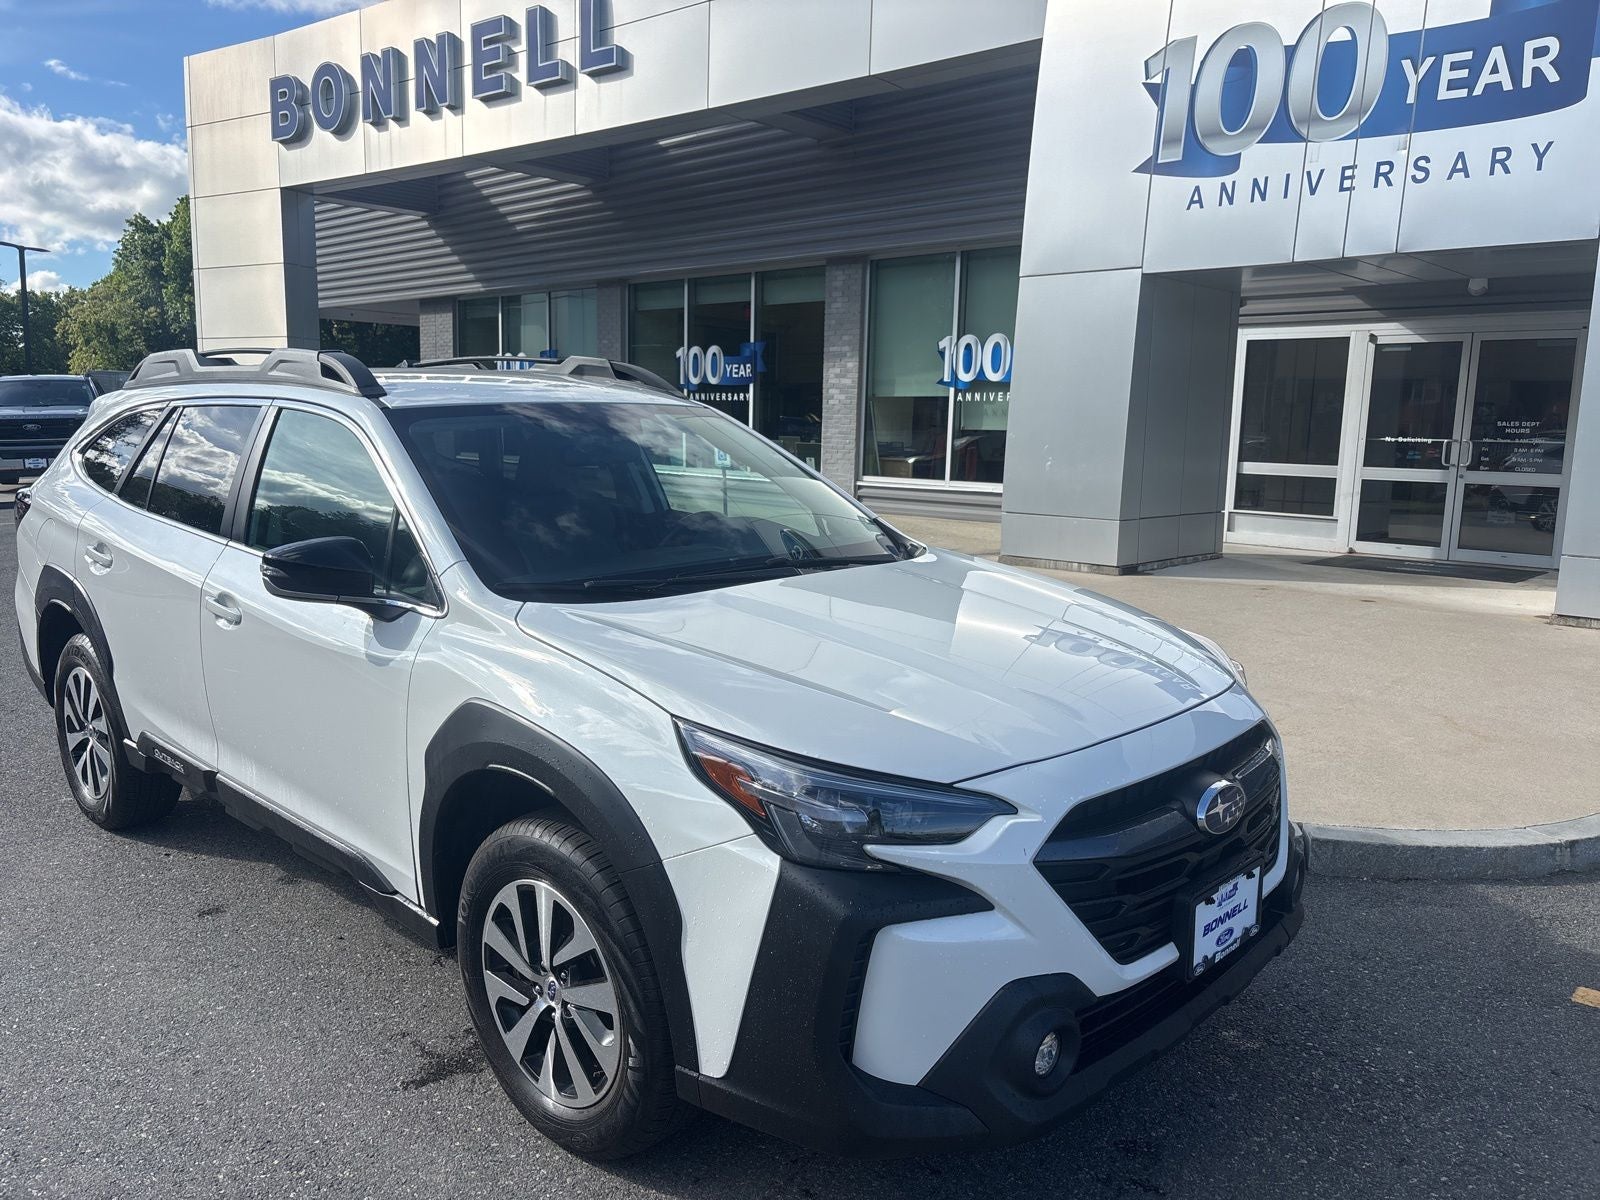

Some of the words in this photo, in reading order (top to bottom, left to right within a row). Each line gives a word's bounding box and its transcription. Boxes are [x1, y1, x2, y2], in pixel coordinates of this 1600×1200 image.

[270, 0, 626, 143] BONNELL
[1144, 1, 1390, 163] 100
[1401, 36, 1561, 104] YEAR
[1186, 141, 1555, 210] ANNIVERSARY
[676, 345, 724, 385] 100
[725, 363, 752, 378] YEAR
[938, 333, 1011, 382] 100
[689, 392, 751, 401] ANNIVERSARY
[1202, 898, 1249, 938] BONNELL
